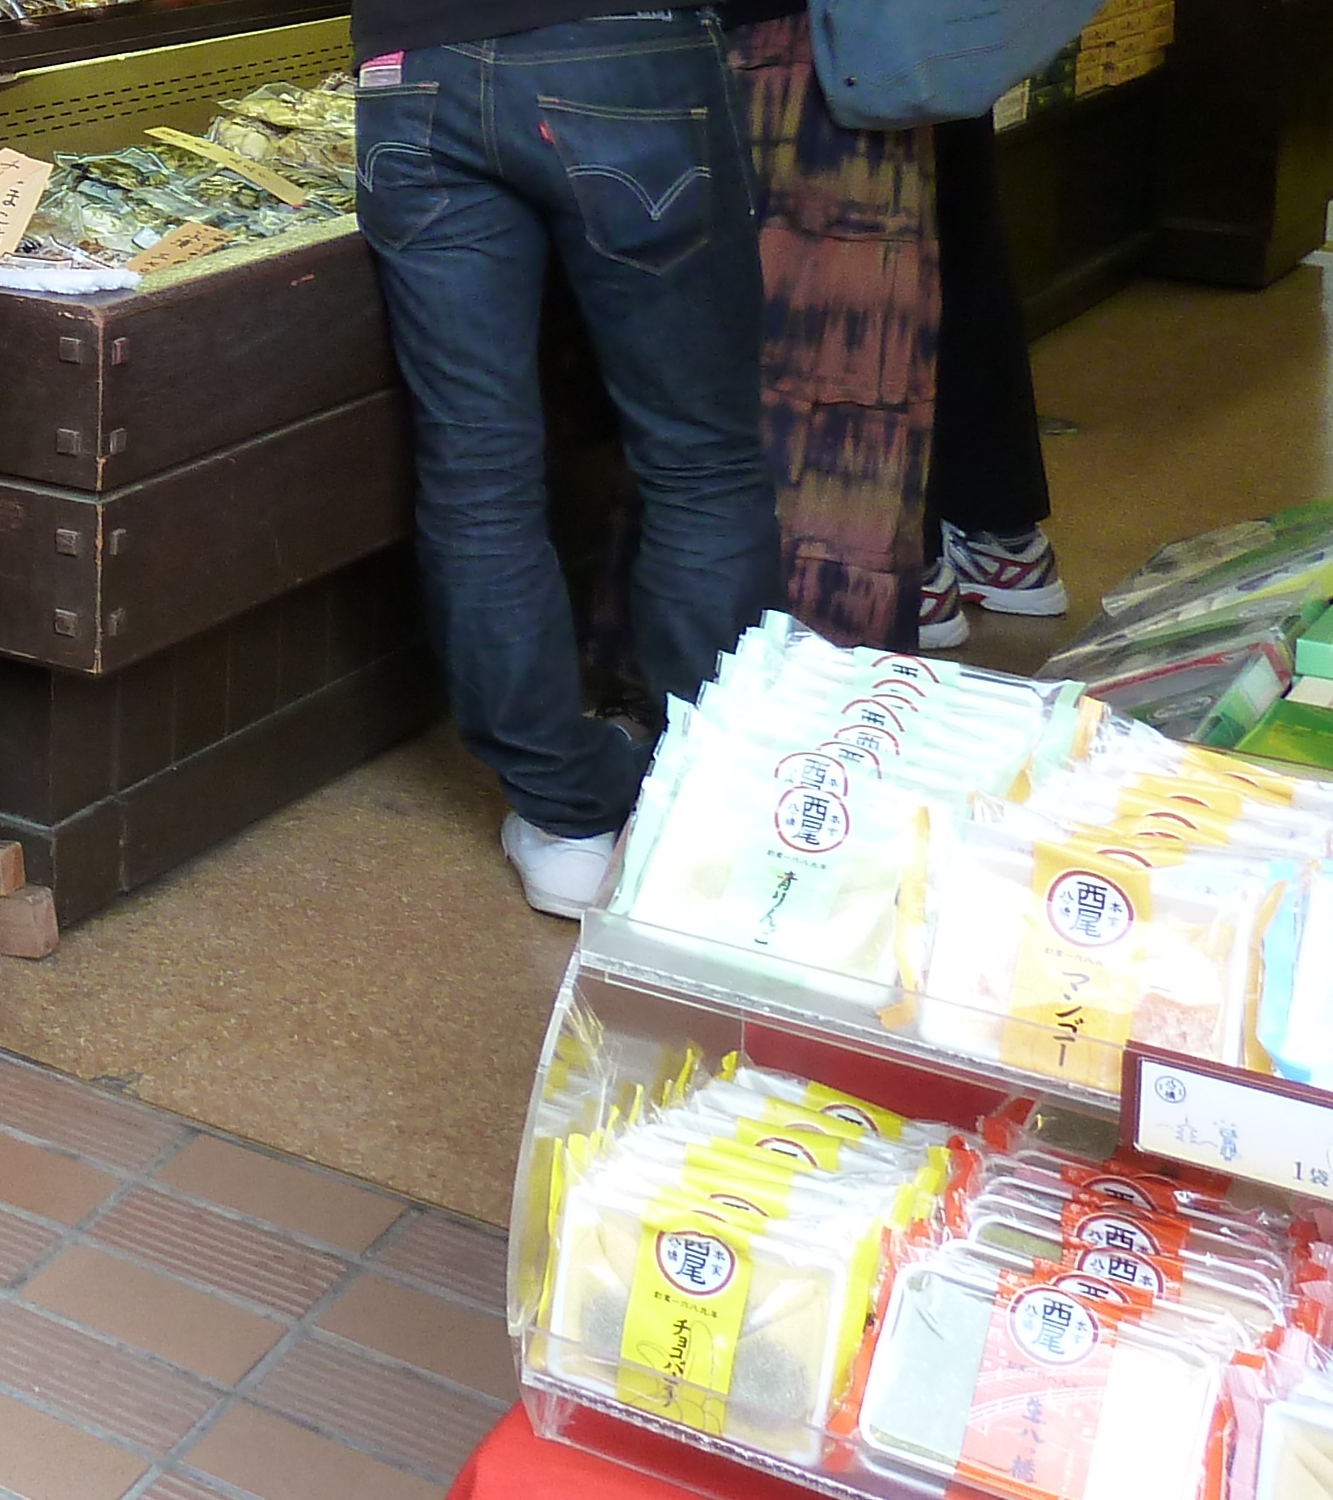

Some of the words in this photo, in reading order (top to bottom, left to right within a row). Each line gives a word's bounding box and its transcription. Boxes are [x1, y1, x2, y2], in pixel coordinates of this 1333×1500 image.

[790, 793, 830, 846] 西尾
[1070, 880, 1109, 939] 西尾
[1052, 971, 1091, 1067] マンゴー
[1030, 1296, 1075, 1357] 西尾
